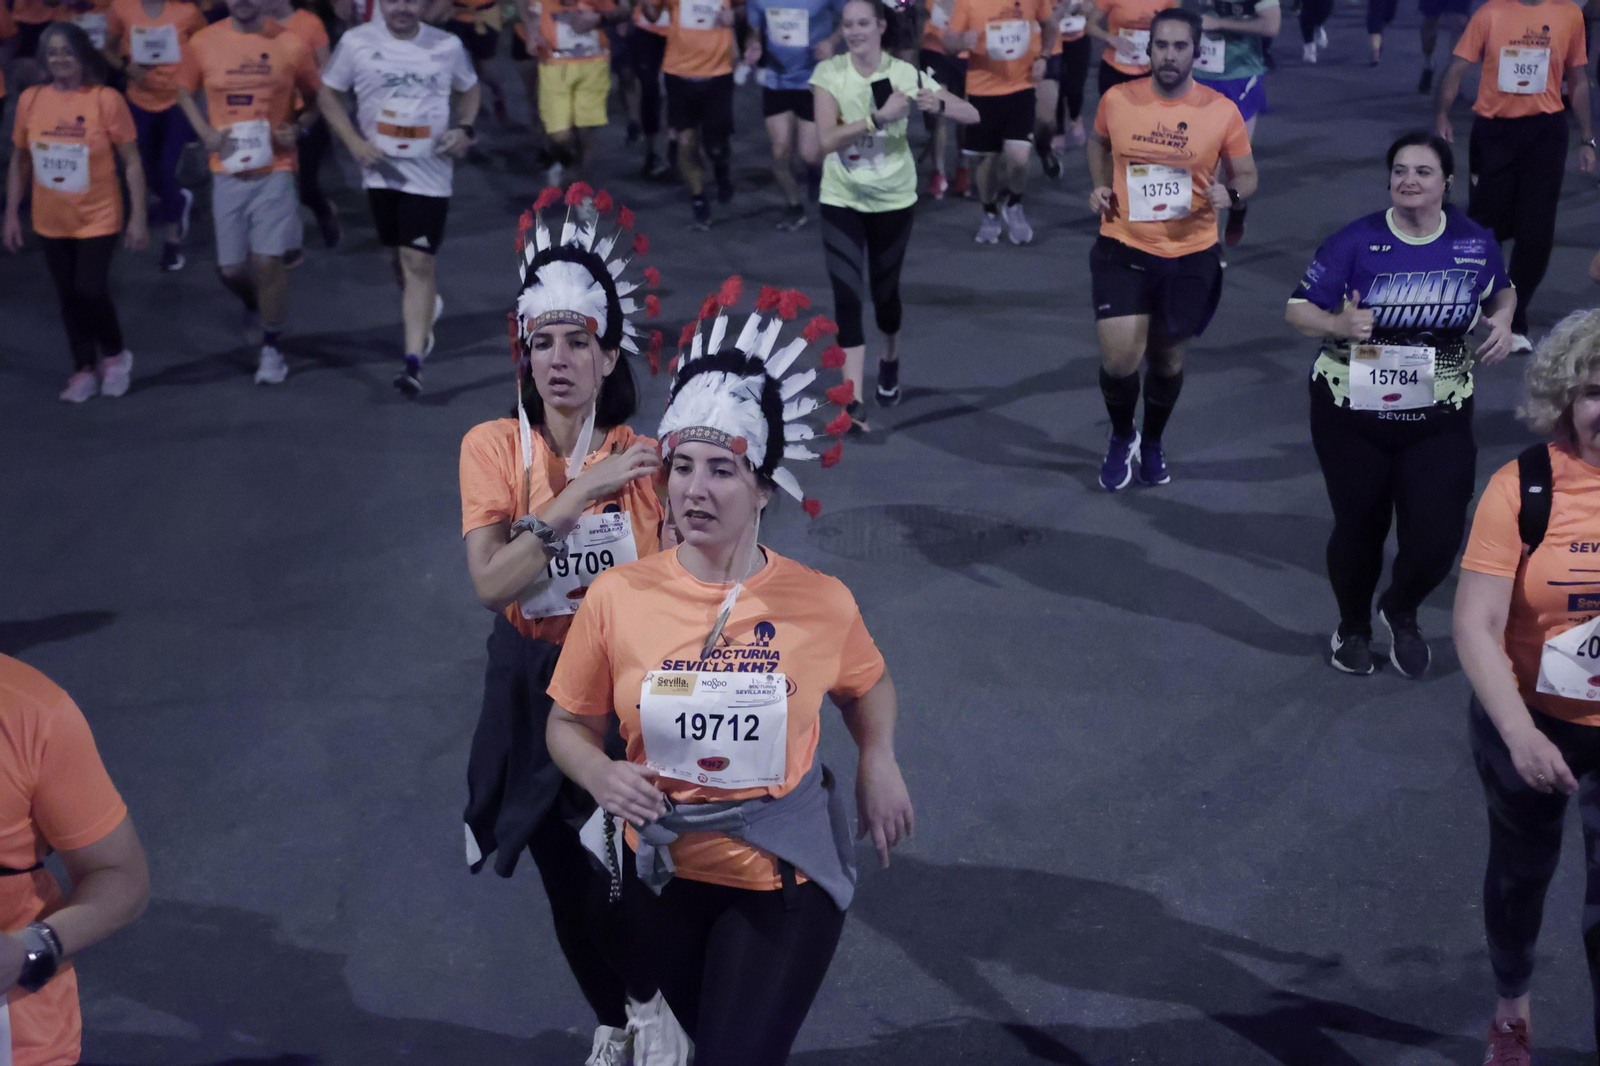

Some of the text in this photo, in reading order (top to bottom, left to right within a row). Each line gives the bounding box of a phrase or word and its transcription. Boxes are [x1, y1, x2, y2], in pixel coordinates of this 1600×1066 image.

[1513, 63, 1539, 76] 3657
[1131, 134, 1166, 146] SEVILLA
[1141, 181, 1180, 198] 13753
[1361, 268, 1478, 305] AMATE
[1373, 304, 1475, 329] RUNNERS
[1369, 368, 1419, 386] 15784
[1378, 411, 1426, 421] SEVILLA
[547, 549, 615, 579] 19709
[661, 659, 736, 673] SEVILLA
[675, 712, 760, 741] 19712
